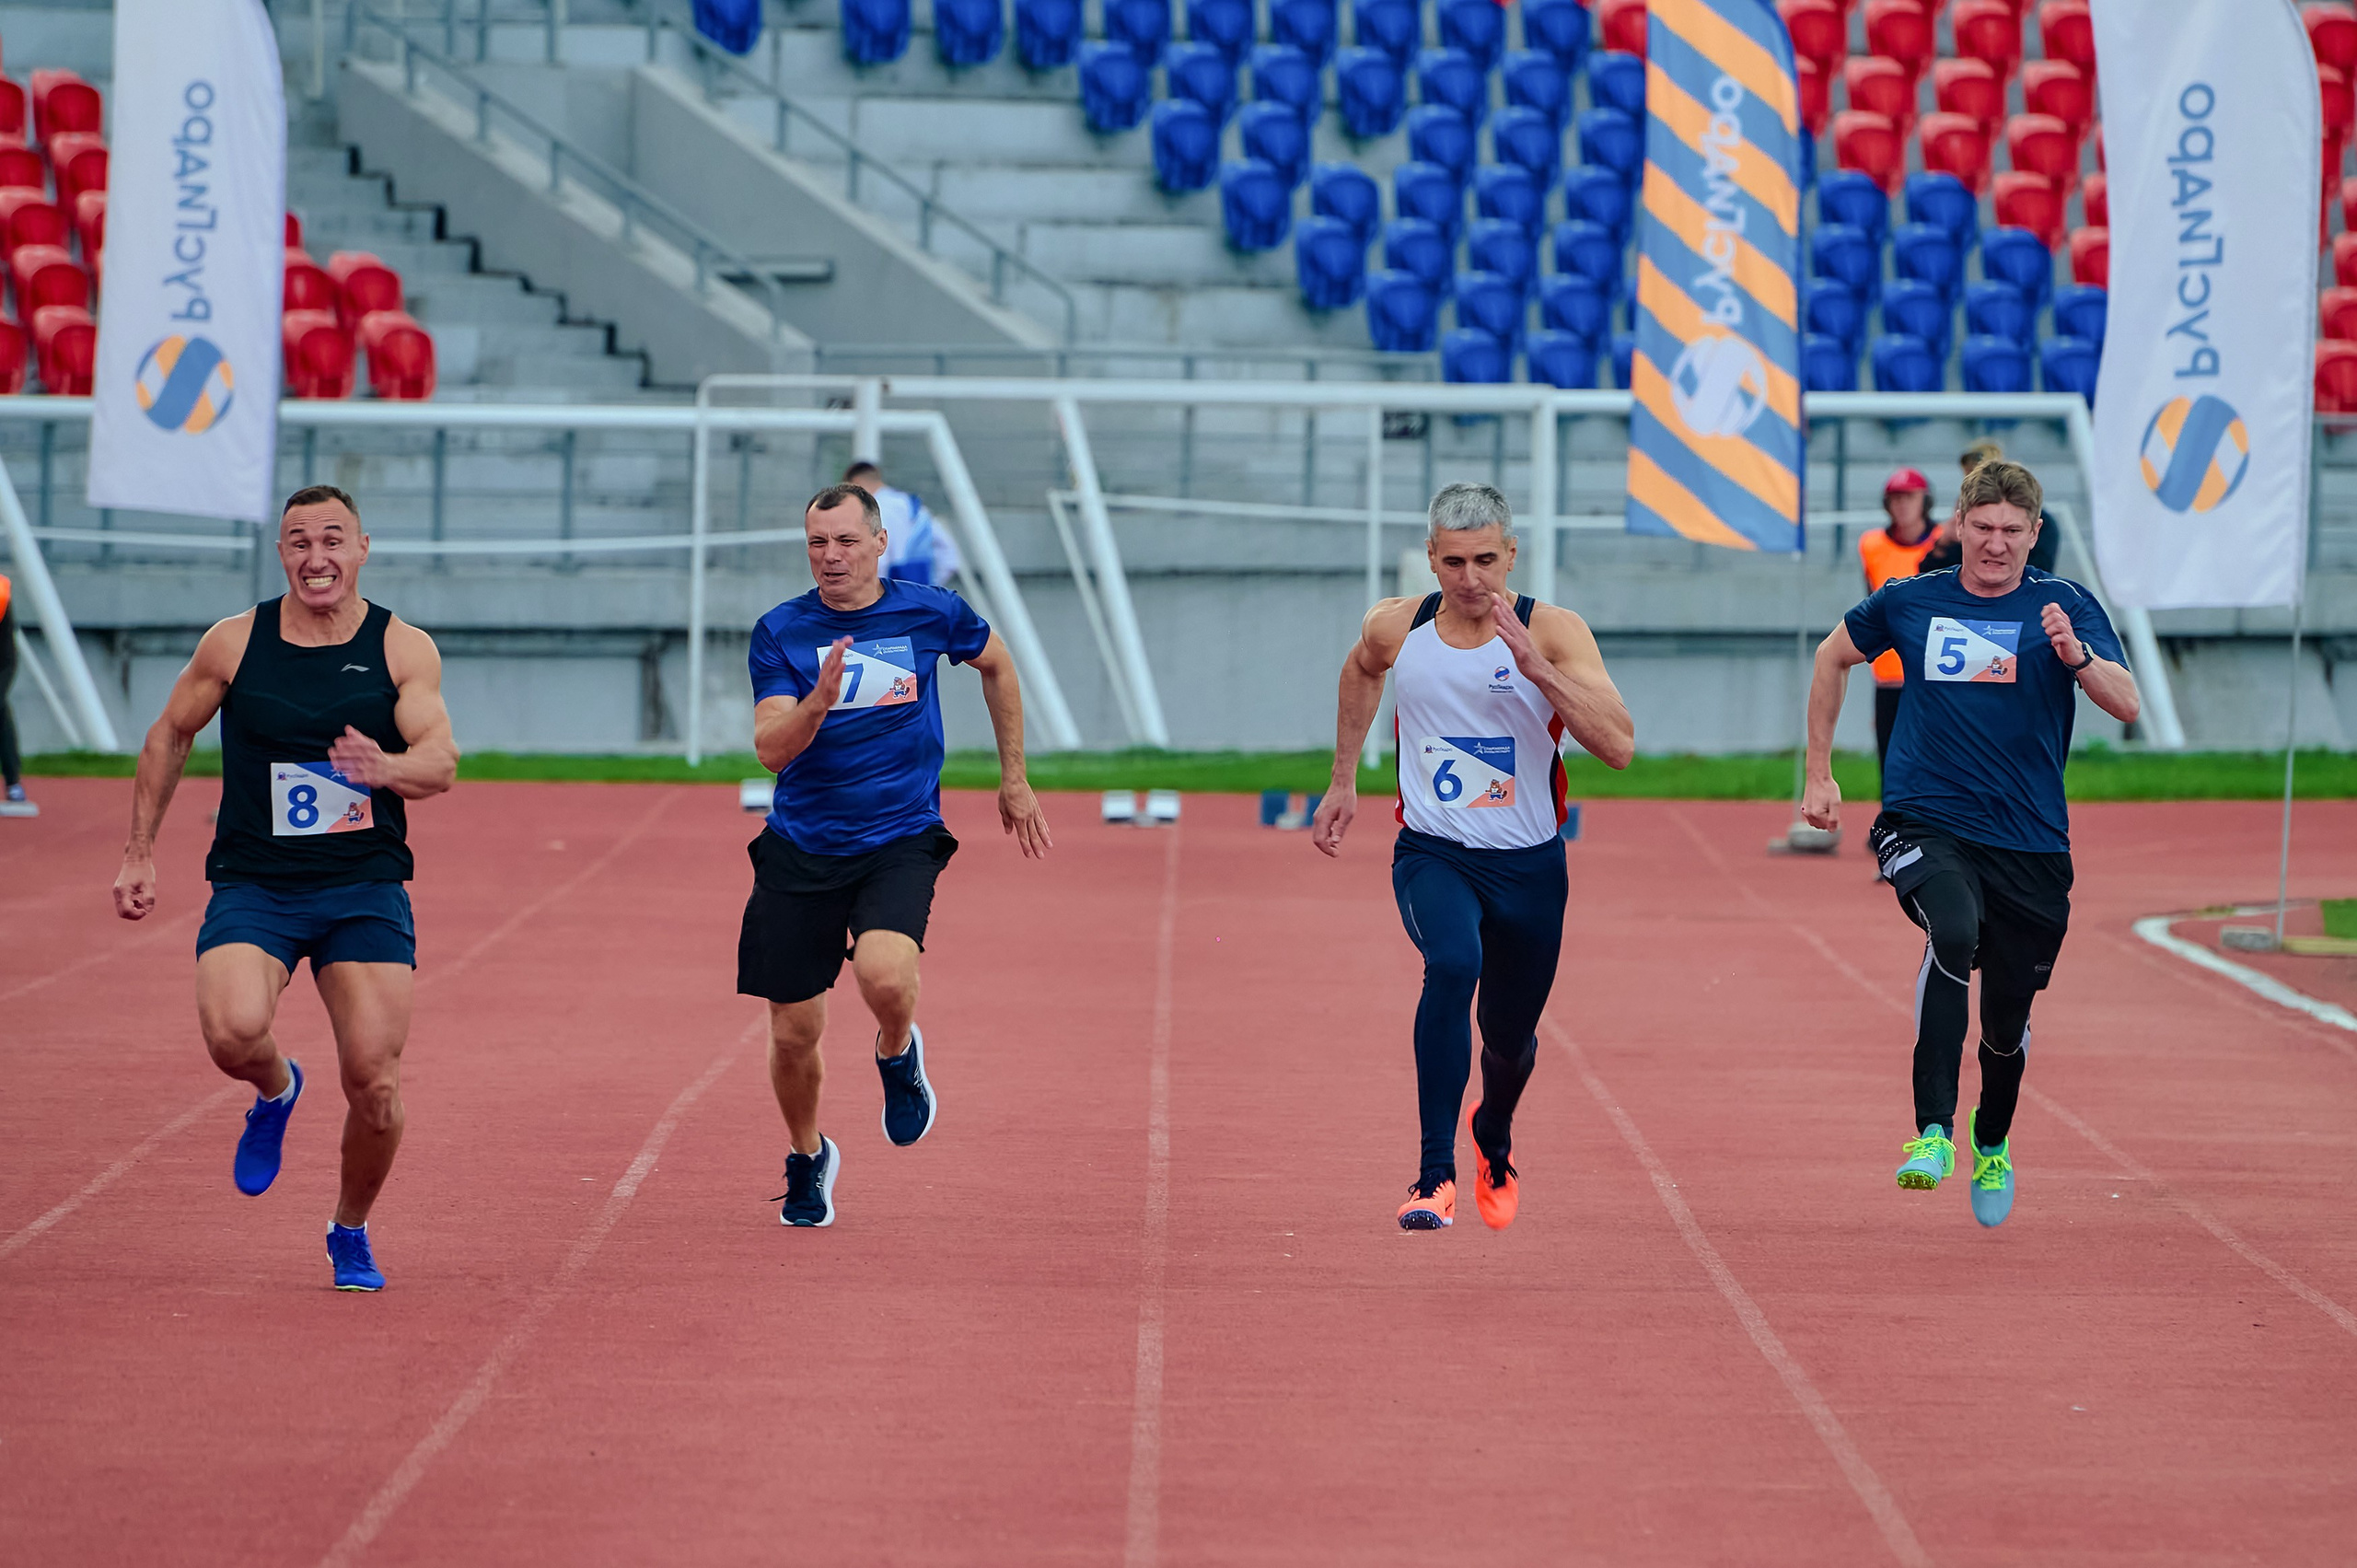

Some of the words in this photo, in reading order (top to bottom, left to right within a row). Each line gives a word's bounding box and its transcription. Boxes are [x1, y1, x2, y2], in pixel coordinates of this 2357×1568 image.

[1937, 637, 1968, 675] 5
[842, 663, 864, 703] 7
[1433, 760, 1462, 802] 6
[287, 784, 319, 829] 8
